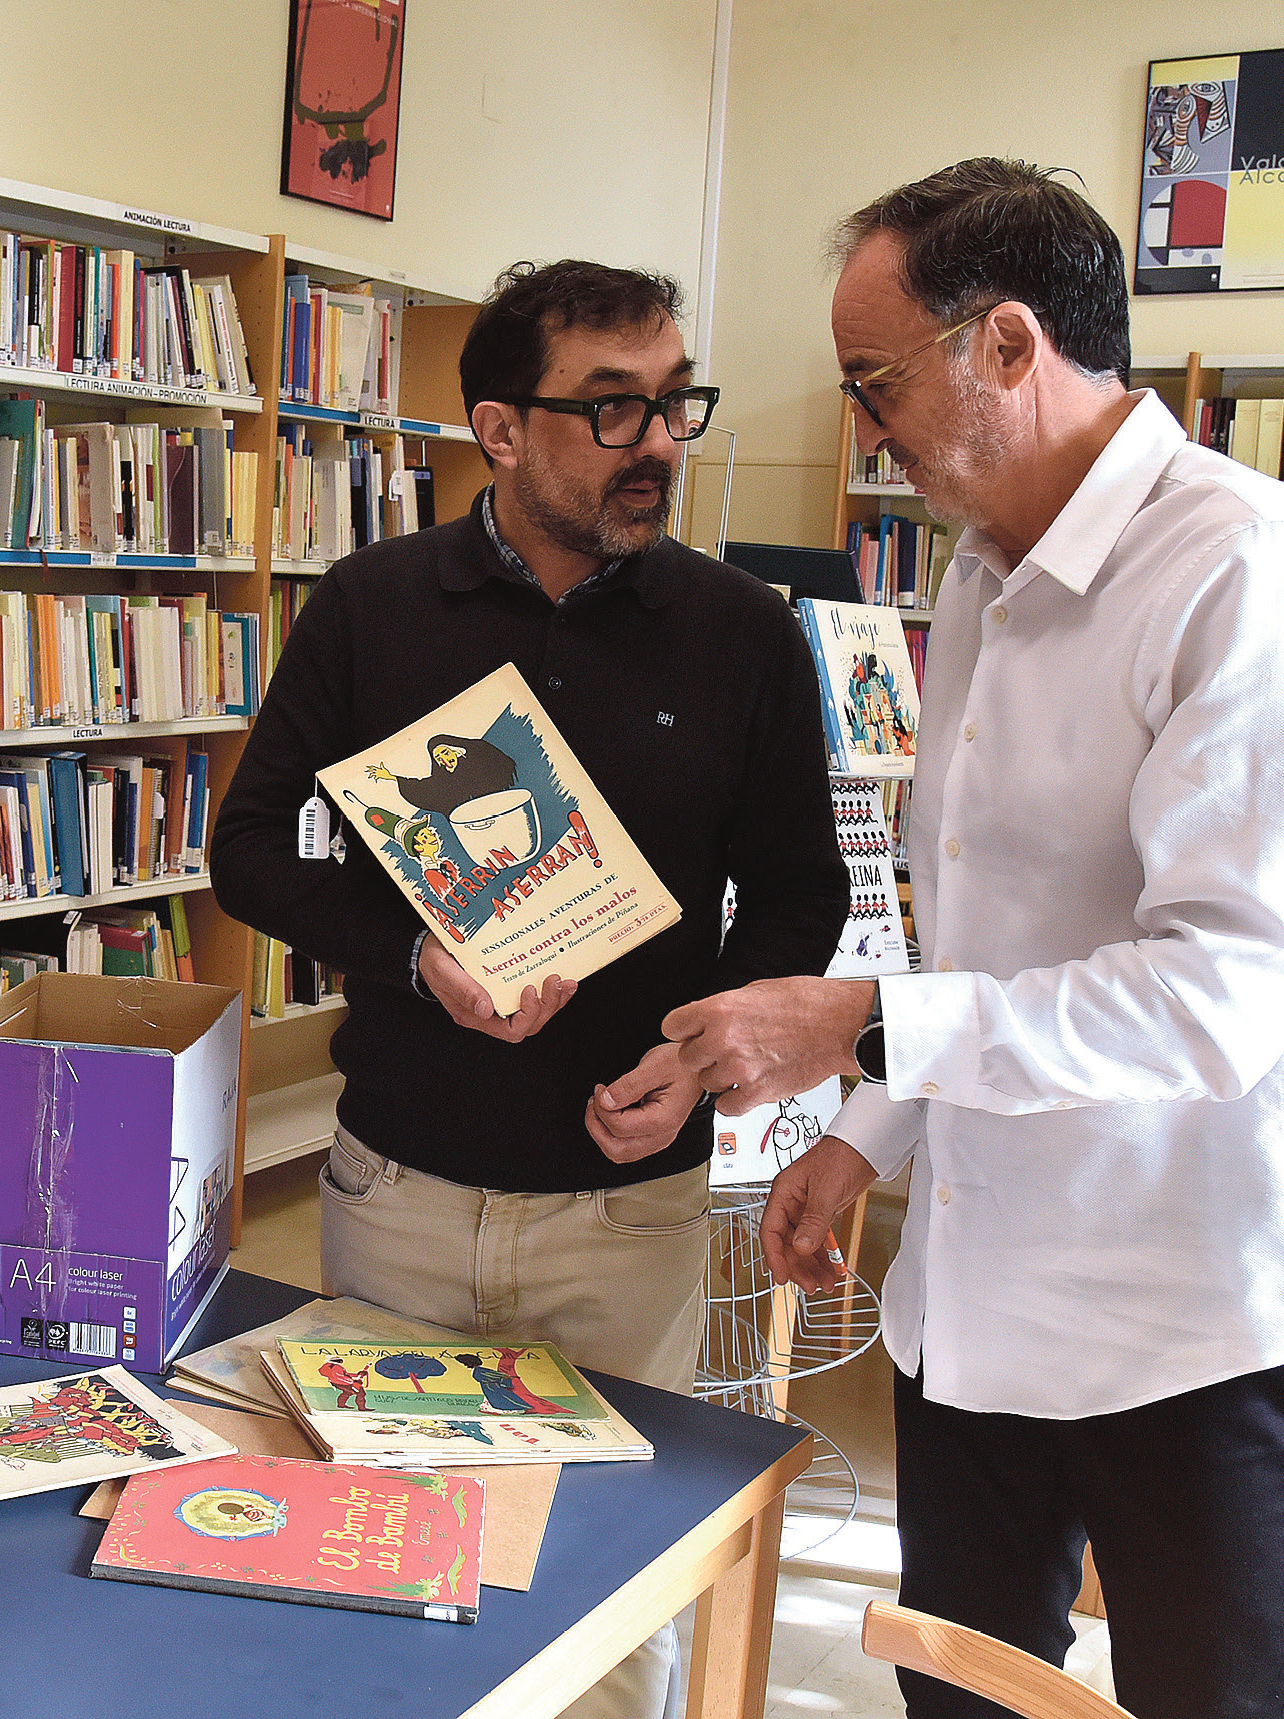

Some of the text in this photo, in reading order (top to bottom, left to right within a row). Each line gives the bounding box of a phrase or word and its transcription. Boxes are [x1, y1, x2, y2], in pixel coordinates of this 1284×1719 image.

[123, 211, 192, 233] ANIMACIÓN LECTURA
[66, 377, 105, 392] LECTURA
[364, 416, 396, 429] LECTURA
[830, 607, 880, 651] El viaje
[481, 872, 619, 956] SENSACIONALES AVENTURAS DE
[481, 884, 638, 977] Aserrín contra los malos
[567, 902, 639, 949] Ilustraciones de Piñana
[9, 1258, 57, 1292] A4
[68, 1265, 123, 1281] colour laser
[171, 1223, 216, 1301] colour laser
[68, 1285, 137, 1301] for colour laser printing
[69, 1278, 87, 1287] Bright
[106, 1282, 124, 1291] paper
[317, 1486, 372, 1571] El Bombo
[366, 1492, 410, 1574] de Bambi
